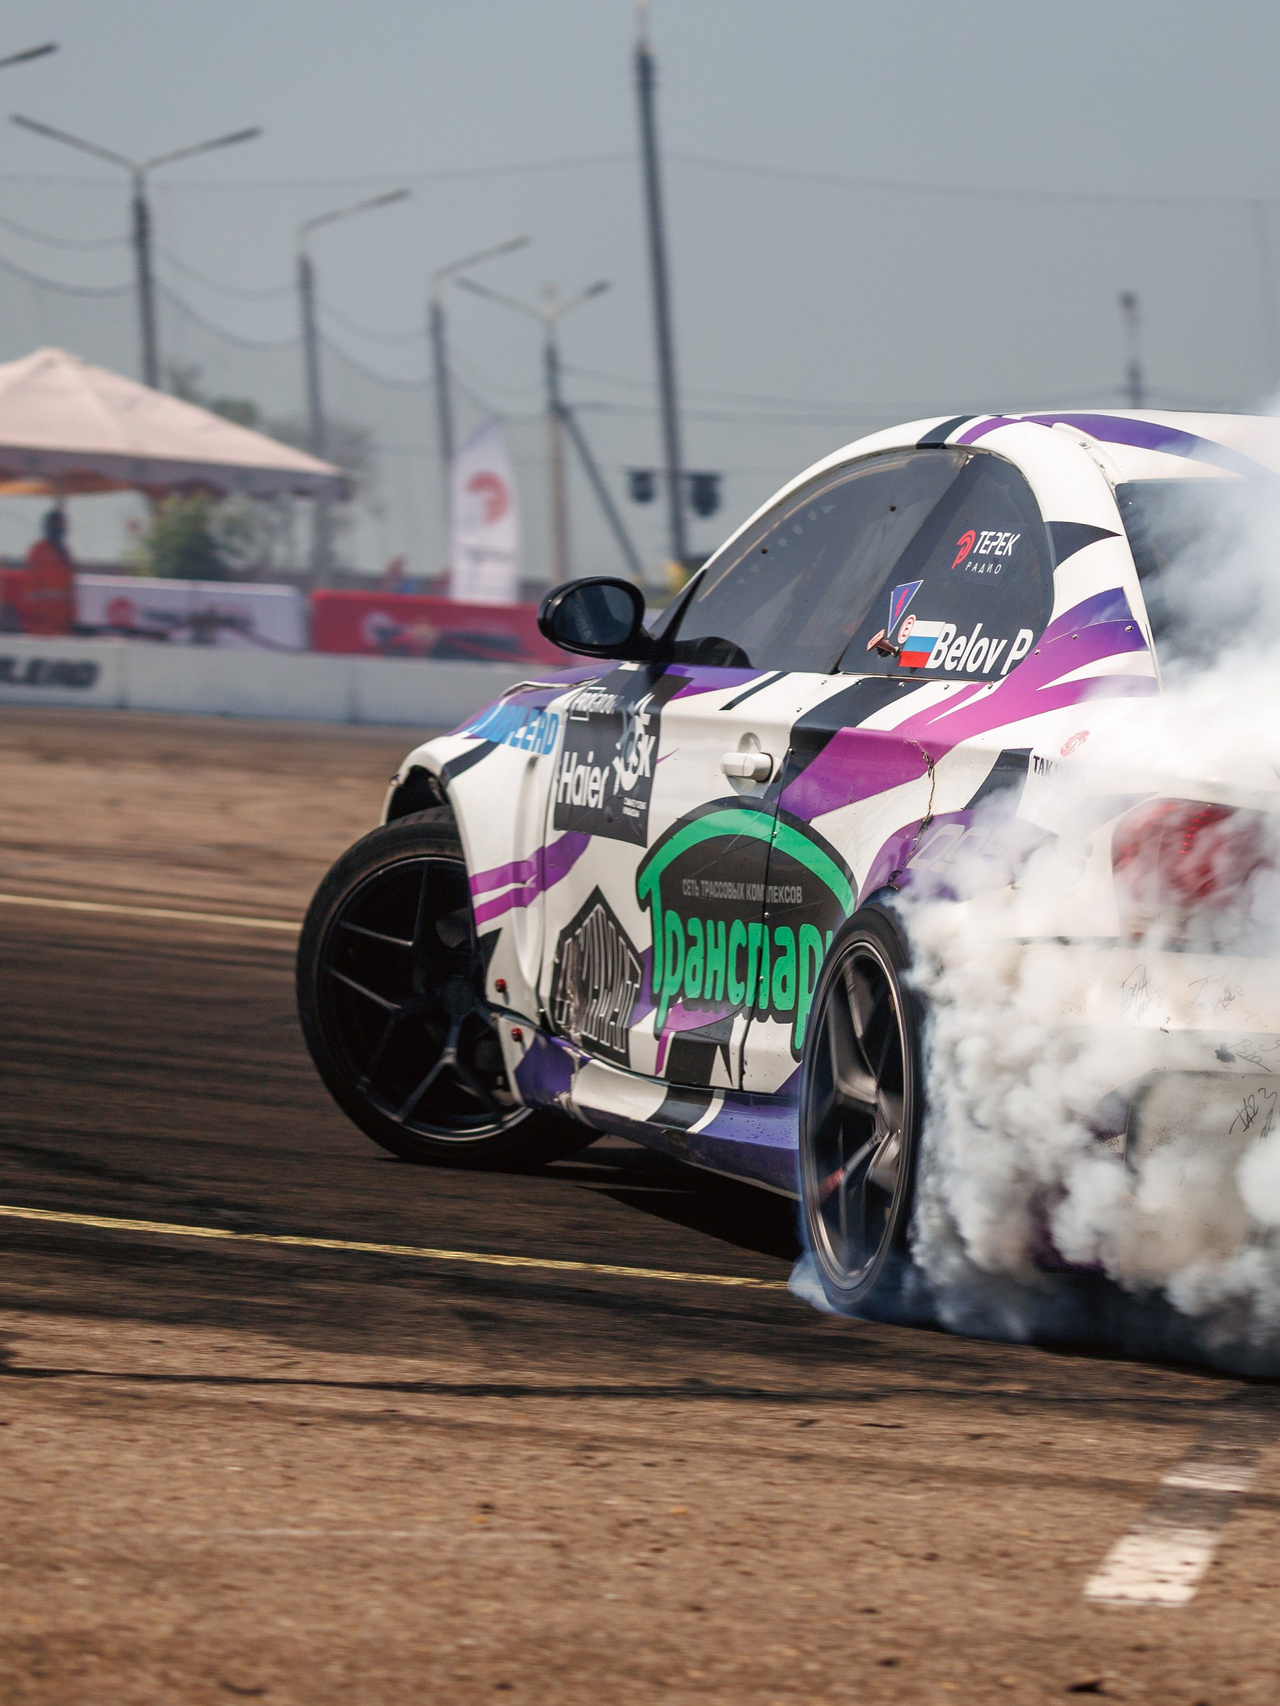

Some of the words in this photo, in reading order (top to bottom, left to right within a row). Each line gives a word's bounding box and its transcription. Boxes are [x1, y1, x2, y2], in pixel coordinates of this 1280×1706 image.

[965, 561, 1003, 575] РАДИО
[925, 622, 1008, 674] Belov
[1000, 628, 1034, 675] P
[557, 751, 610, 809] Haier
[682, 879, 699, 896] СЕТЬ
[701, 880, 745, 899] ТРАССОВЫХ
[746, 884, 803, 904] КОМЛЕКСОВ
[637, 809, 857, 1050] Транспар
